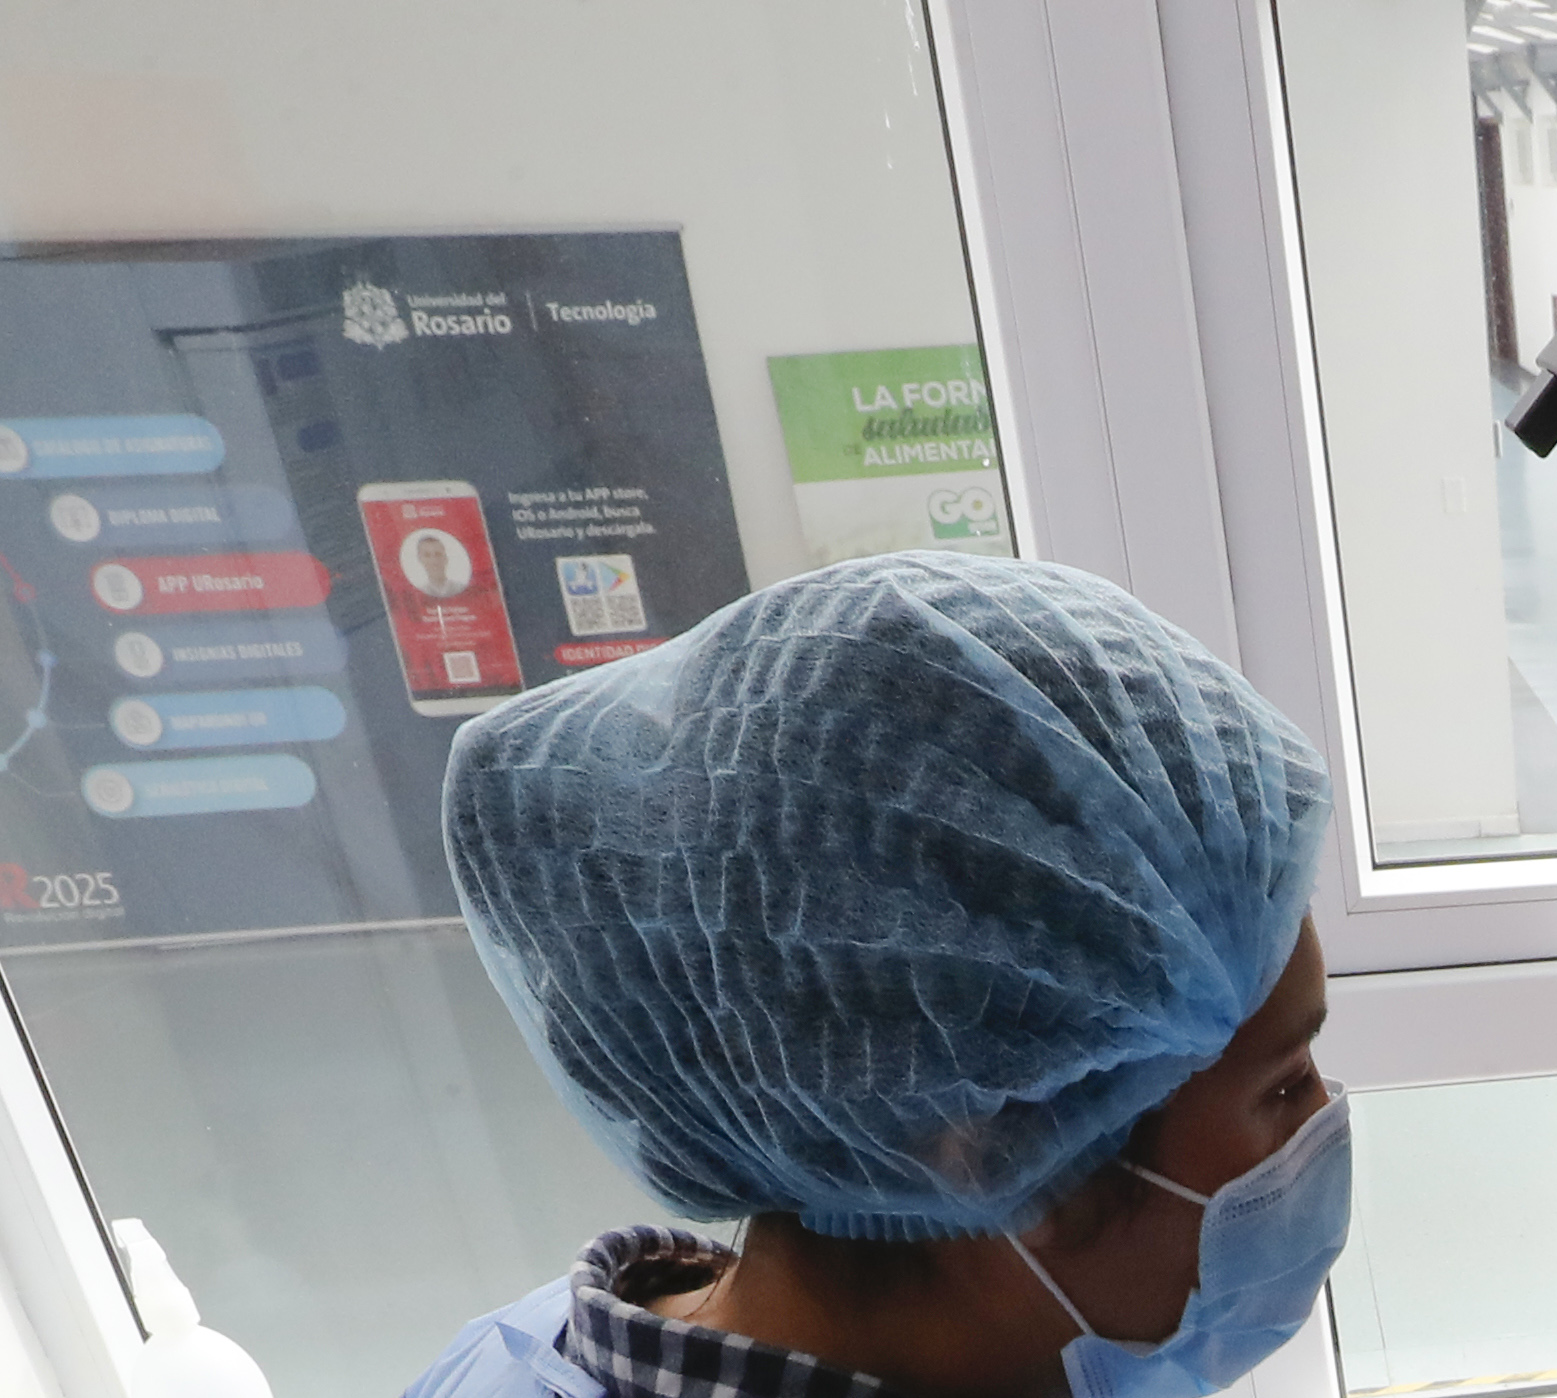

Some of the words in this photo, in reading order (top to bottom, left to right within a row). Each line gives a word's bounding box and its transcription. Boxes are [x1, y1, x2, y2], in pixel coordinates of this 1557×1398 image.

[407, 292, 482, 308] Universidad
[484, 291, 507, 306] del
[411, 308, 513, 336] Rosario
[546, 300, 657, 326] Tecnología
[852, 385, 898, 413] LA
[585, 487, 611, 501] APP
[168, 506, 222, 524] DIGITAL
[157, 575, 189, 592] APP
[192, 574, 265, 592] URosario
[237, 641, 304, 659] DIGITALES
[561, 644, 635, 662] IDENTIDAD
[32, 871, 120, 909] 2025
